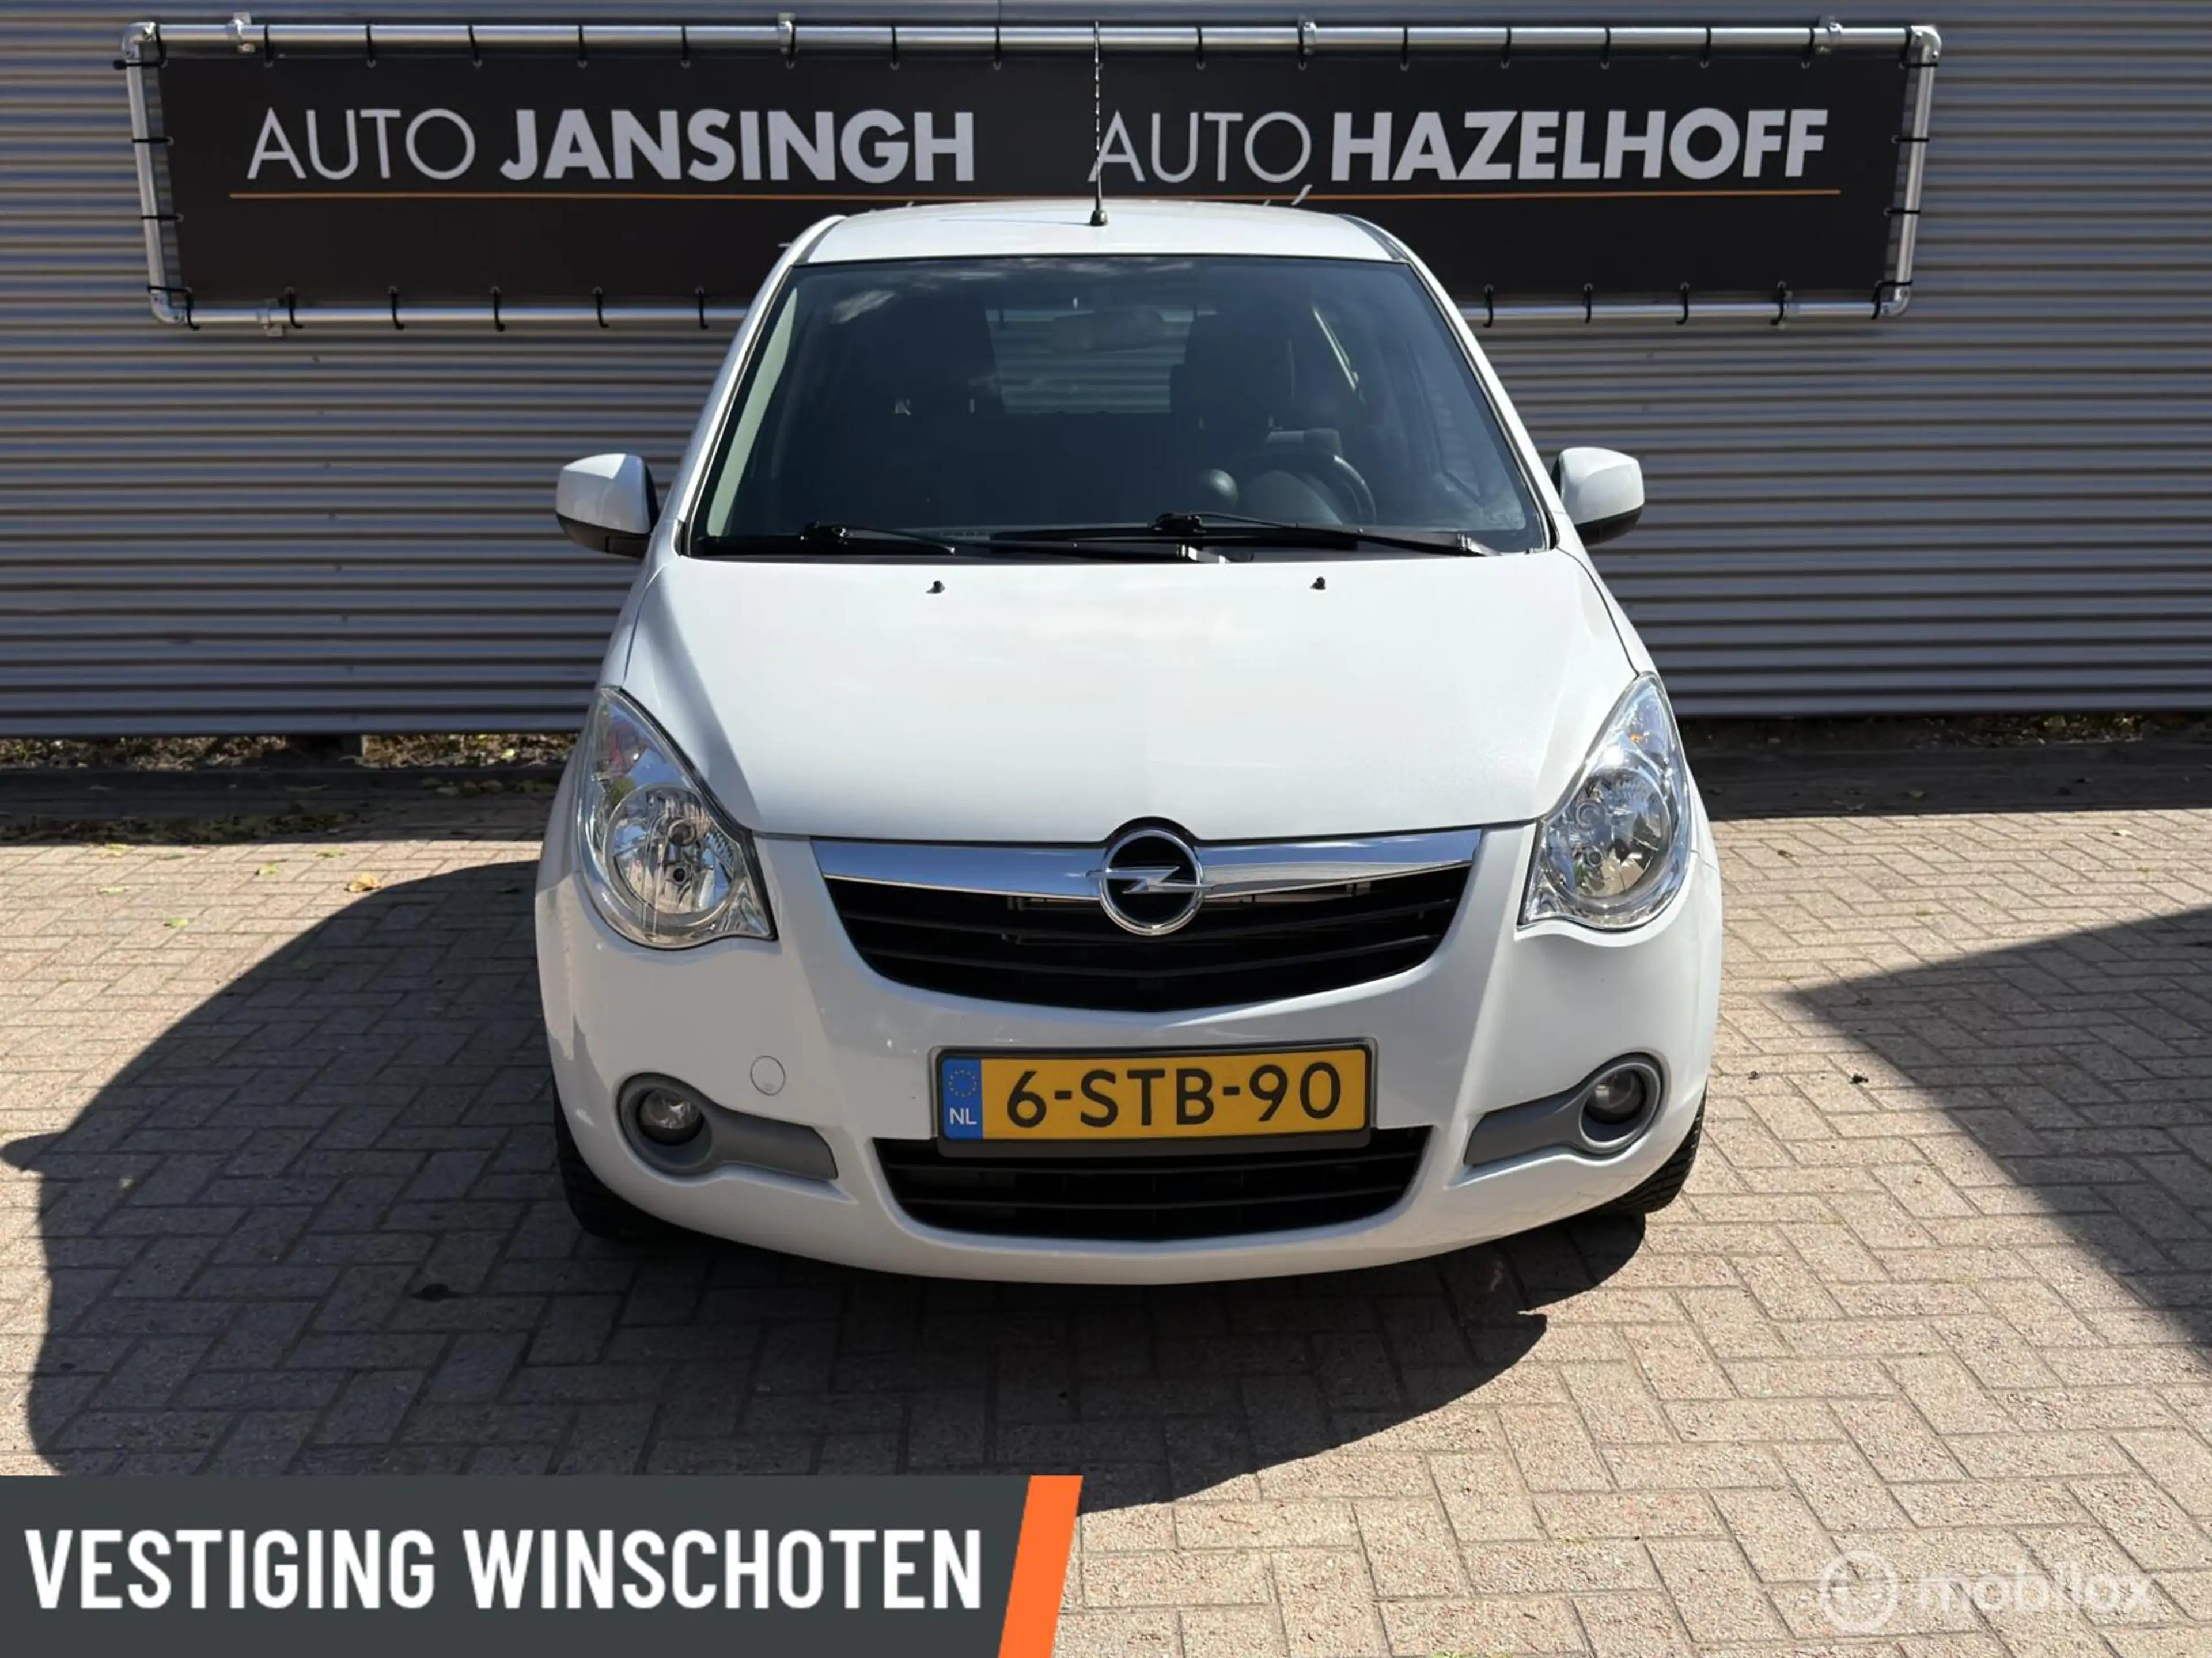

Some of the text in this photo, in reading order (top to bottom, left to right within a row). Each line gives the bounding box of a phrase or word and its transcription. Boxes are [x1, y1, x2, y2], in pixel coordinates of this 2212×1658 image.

[248, 108, 974, 183] AUTO JANSINGH
[1089, 108, 1828, 183] AUTO HAZELHOFF
[950, 1108, 977, 1125] NL
[1006, 1061, 1341, 1128] 6-STB-90
